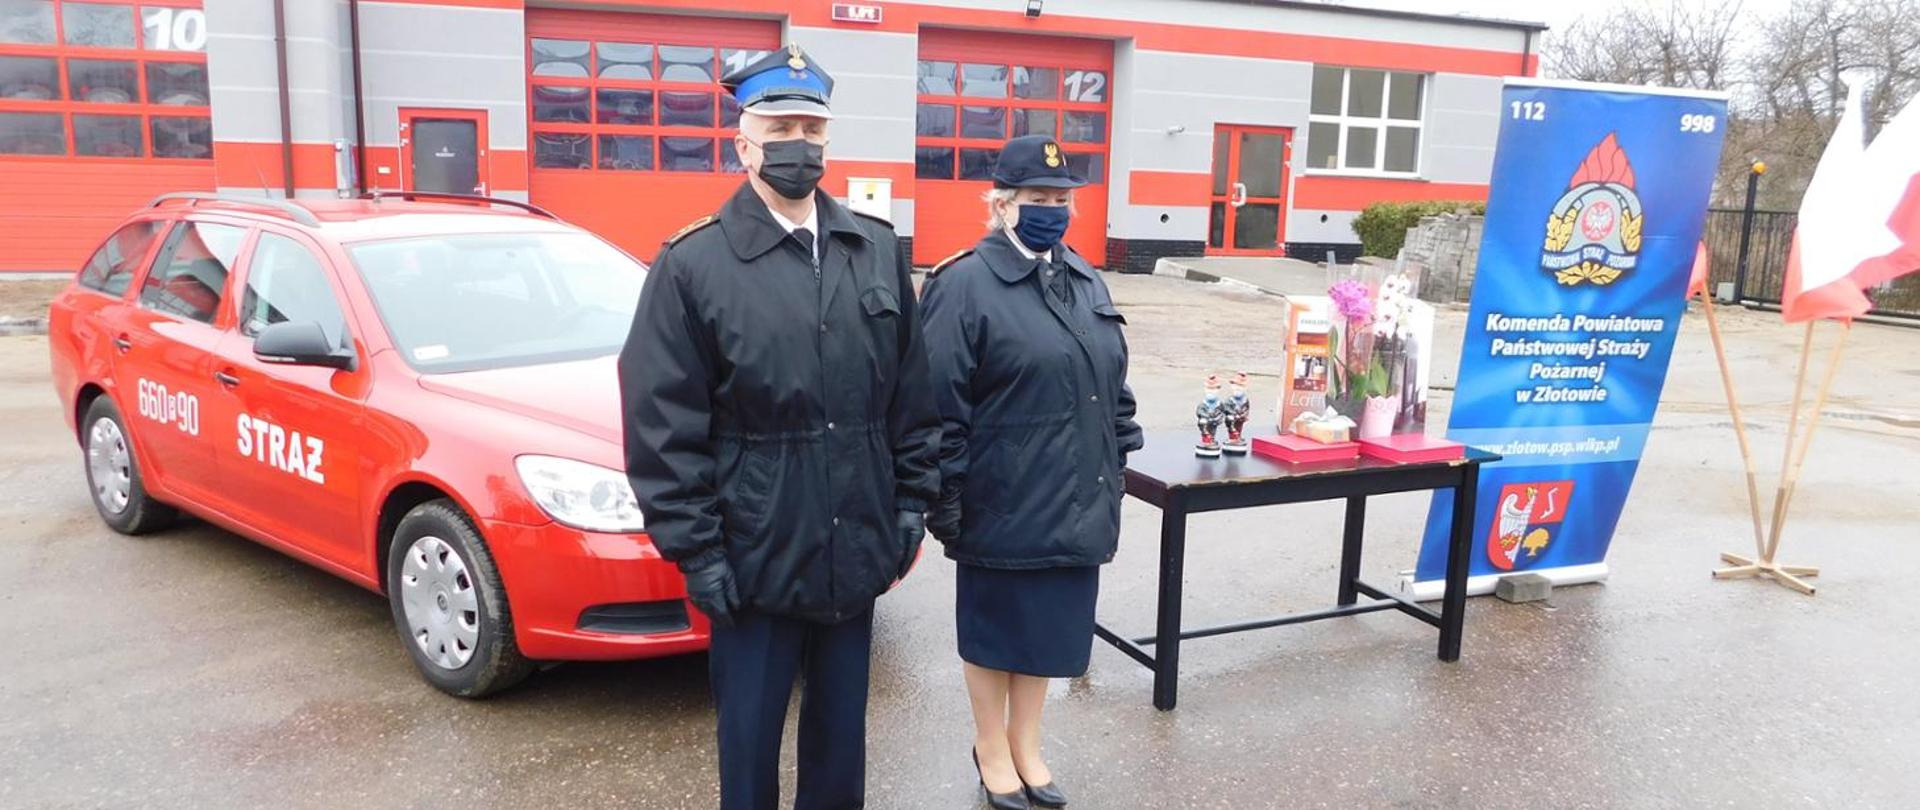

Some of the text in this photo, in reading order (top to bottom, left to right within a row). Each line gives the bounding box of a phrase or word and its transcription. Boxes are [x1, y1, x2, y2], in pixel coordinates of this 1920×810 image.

[144, 8, 207, 51] 10
[1064, 71, 1105, 102] 12
[1511, 101, 1545, 120] 112
[1680, 113, 1716, 133] 998
[1486, 313, 1664, 332] Komenda Powiatowa
[1491, 338, 1650, 359] Państwowej Straży
[1530, 362, 1606, 382] Pożarnej
[1516, 386, 1607, 402] w Złotowie
